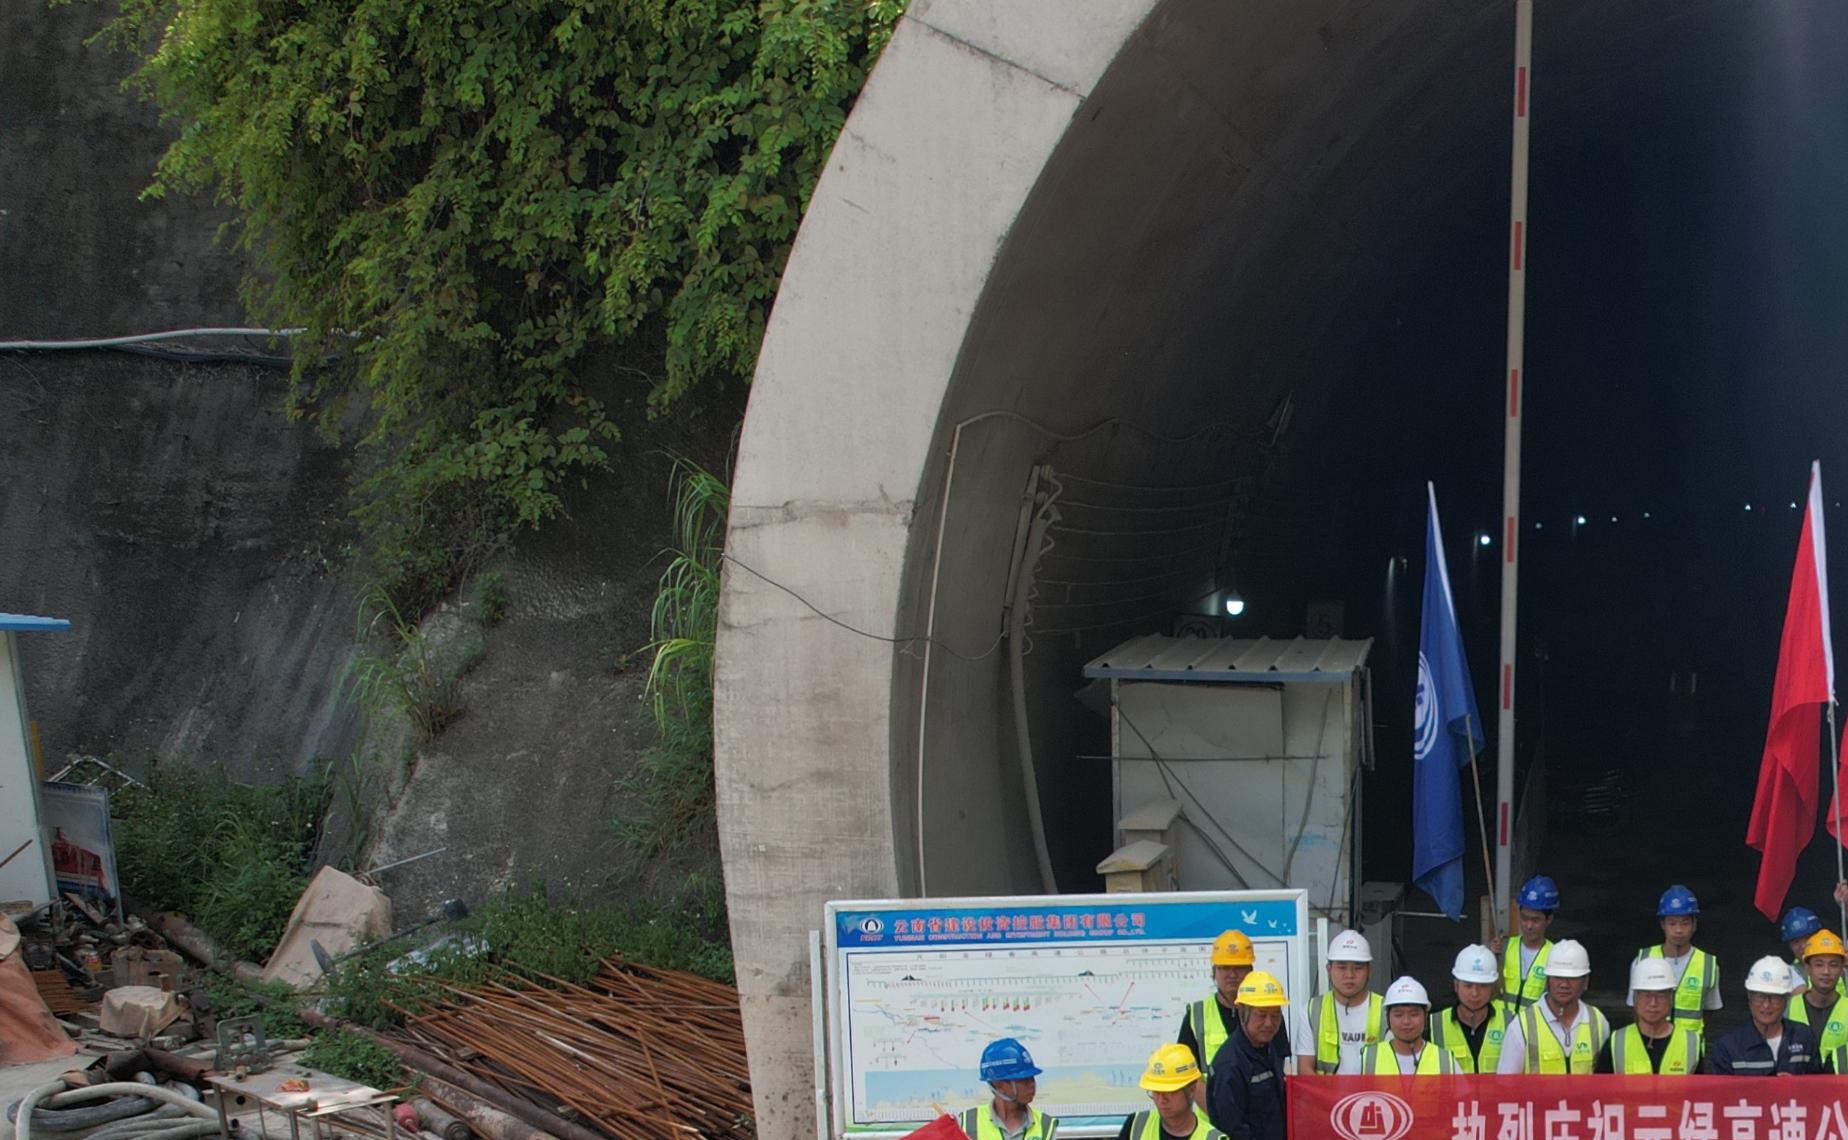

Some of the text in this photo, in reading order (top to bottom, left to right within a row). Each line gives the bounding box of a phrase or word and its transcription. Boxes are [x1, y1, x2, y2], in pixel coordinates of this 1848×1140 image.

[894, 912, 1146, 934] 云南省建设投资控股集团有限公司
